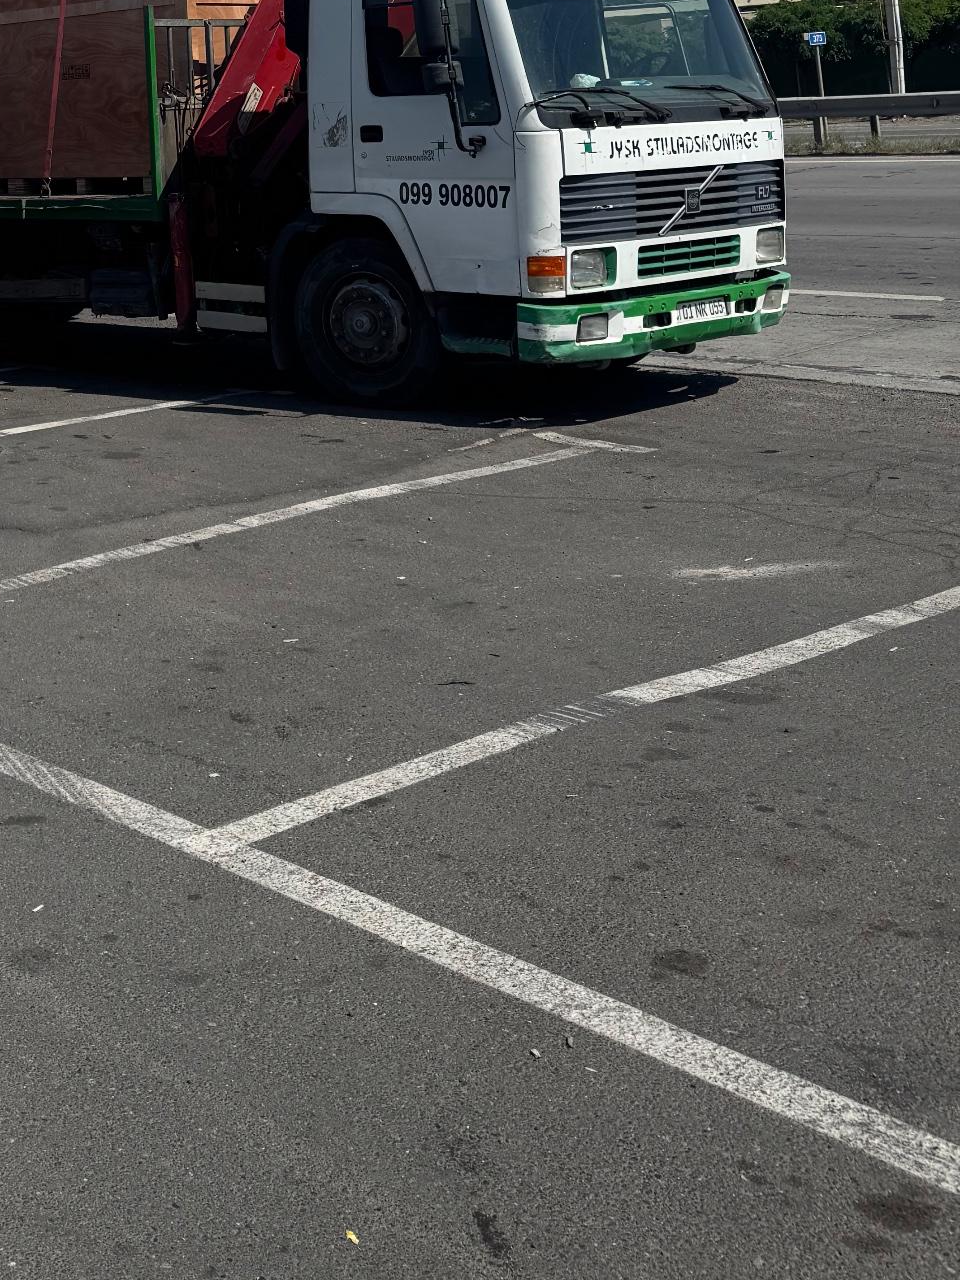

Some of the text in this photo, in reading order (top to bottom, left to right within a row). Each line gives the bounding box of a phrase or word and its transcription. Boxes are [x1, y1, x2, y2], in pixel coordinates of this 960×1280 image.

[609, 139, 641, 158] JYSK
[400, 182, 511, 208] 099 908007
[695, 301, 708, 318] NR
[709, 299, 724, 316] 055
